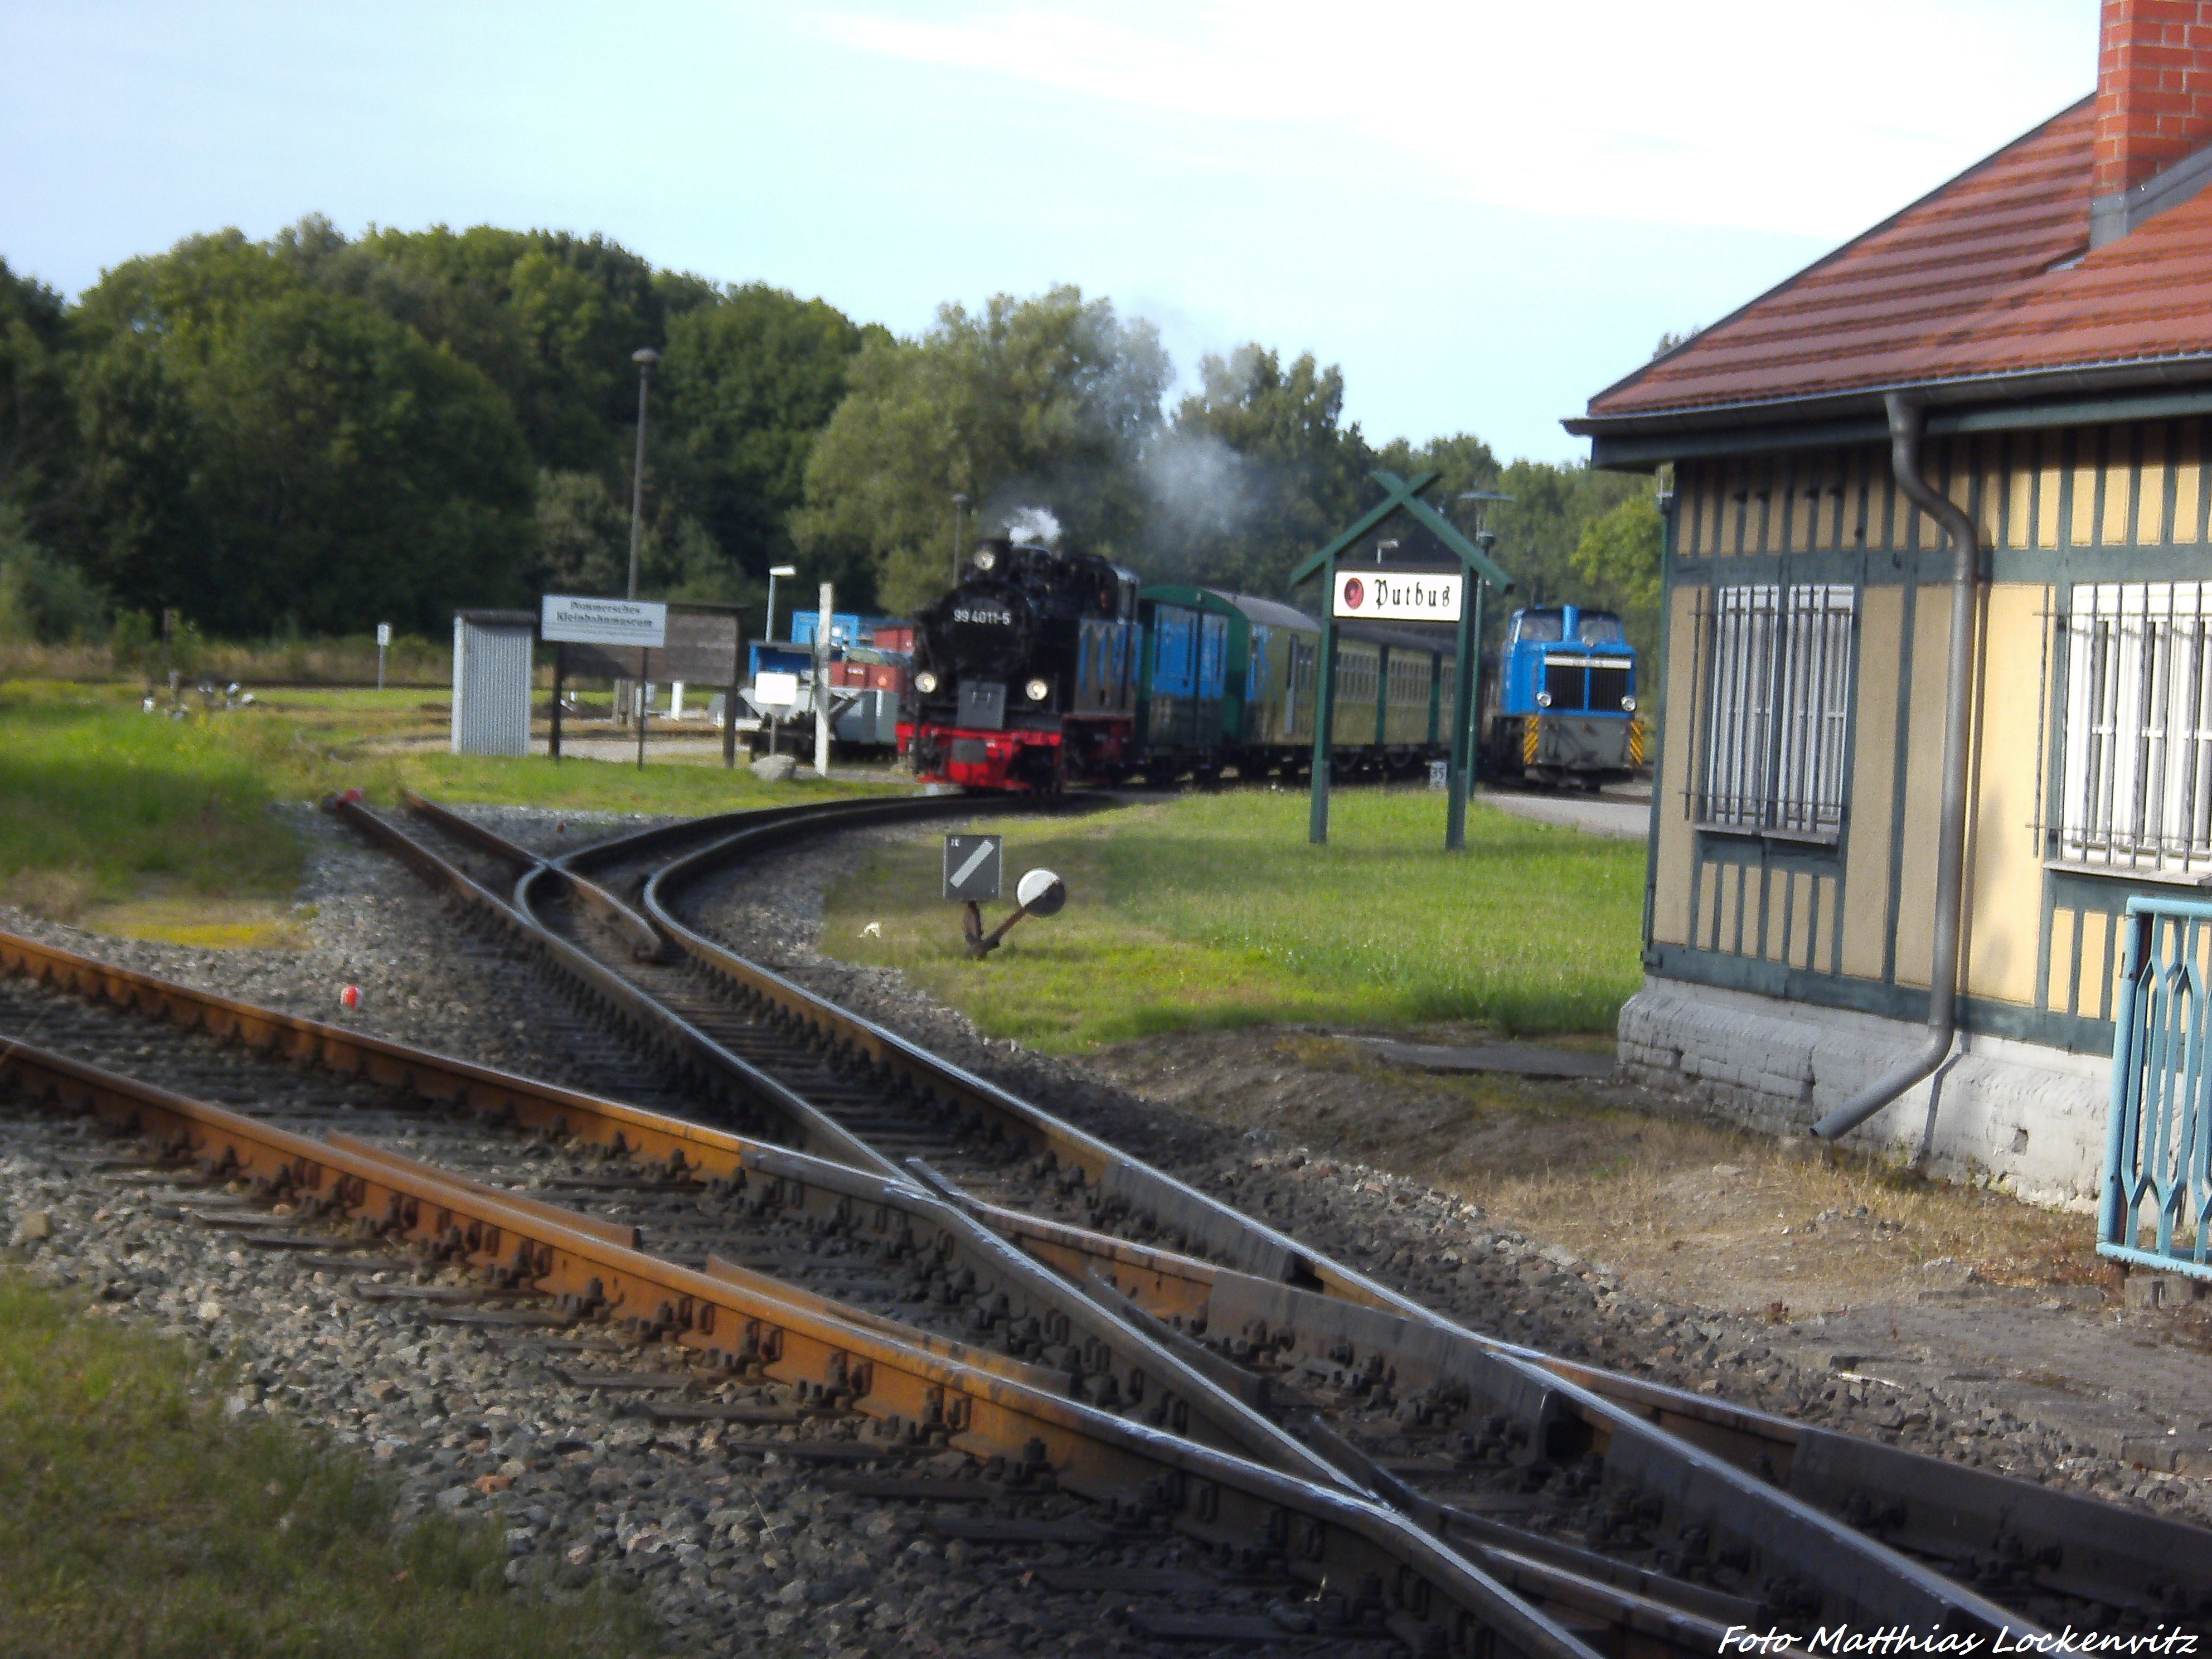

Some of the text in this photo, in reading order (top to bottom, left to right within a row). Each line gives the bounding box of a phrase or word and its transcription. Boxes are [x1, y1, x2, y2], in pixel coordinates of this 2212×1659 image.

[1375, 579, 1450, 610] Putbus
[954, 609, 1011, 625] 99 4011-5
